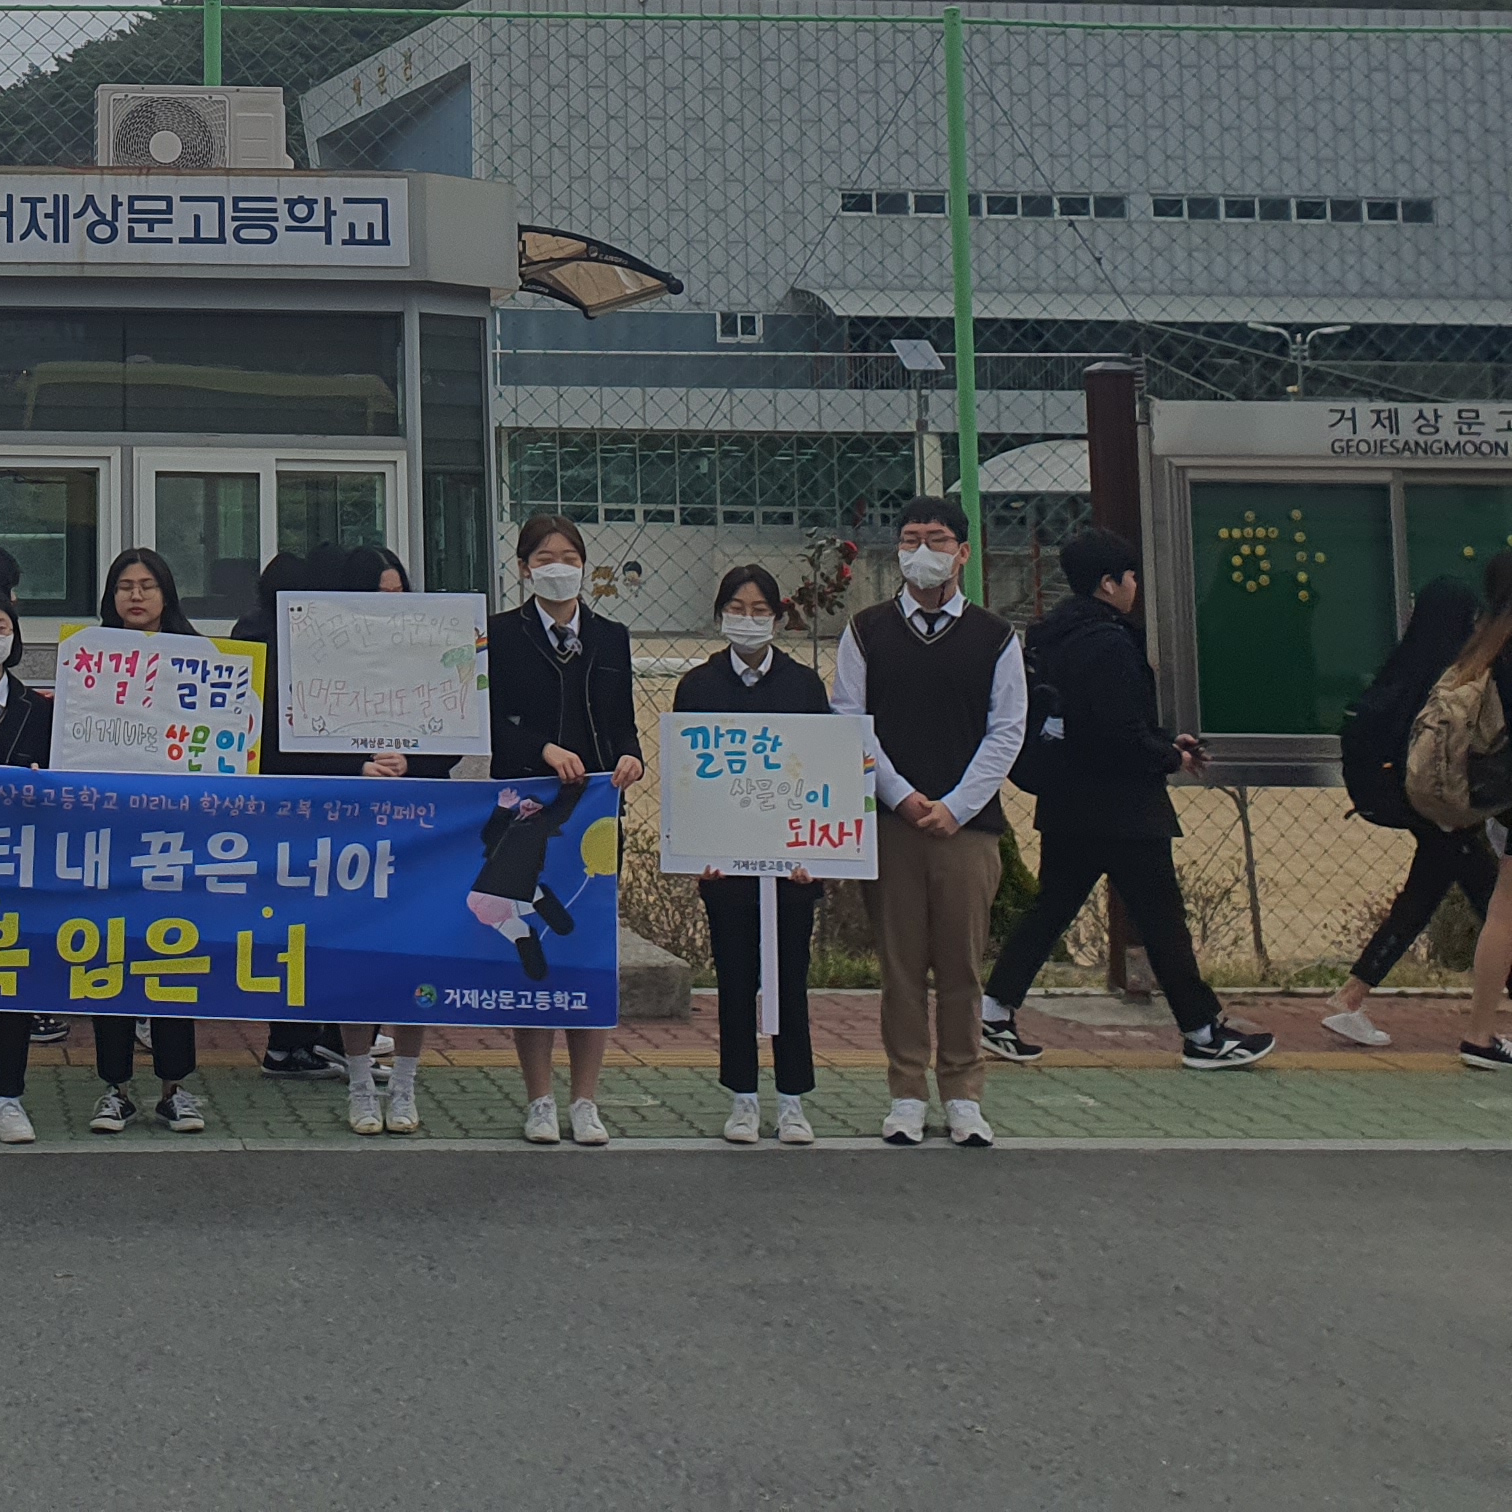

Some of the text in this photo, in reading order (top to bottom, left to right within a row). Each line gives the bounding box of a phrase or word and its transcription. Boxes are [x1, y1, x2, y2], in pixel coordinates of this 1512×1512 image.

[1330, 438, 1509, 457] GEOJESANGMOON
[73, 646, 249, 715] 청결! 깔끔!
[680, 724, 783, 780] 깔끔한
[129, 791, 189, 813] 미리내
[200, 791, 266, 816] 학생회
[276, 798, 312, 819] 교복
[323, 800, 360, 821] 입기
[370, 801, 435, 829] 캠페인
[730, 778, 830, 811] 상문인이
[785, 817, 864, 854] 되자!
[56, 827, 111, 890] 내
[130, 830, 258, 895] 꿈은
[276, 836, 395, 898] 너야
[56, 916, 211, 1003] 입은
[236, 922, 306, 1007] 너
[444, 988, 589, 1011] 거제상문고등학교
